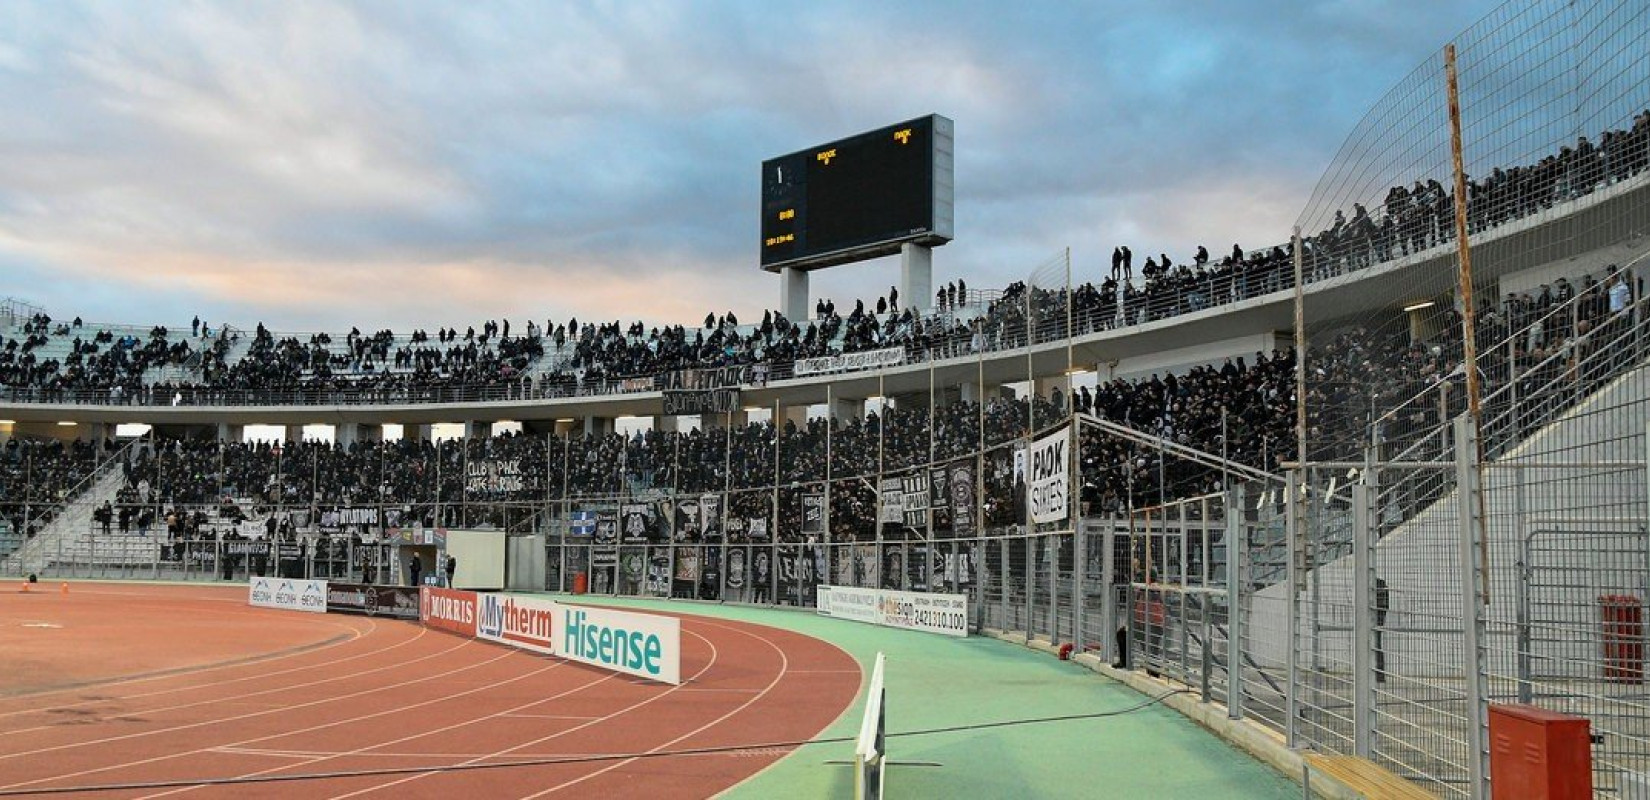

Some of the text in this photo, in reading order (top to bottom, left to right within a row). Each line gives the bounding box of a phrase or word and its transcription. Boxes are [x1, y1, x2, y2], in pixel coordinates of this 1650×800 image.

[1033, 440, 1064, 482] PAOK
[431, 596, 474, 624] MORRIS
[483, 595, 551, 637] Mytherm
[565, 609, 661, 675] Hisense
